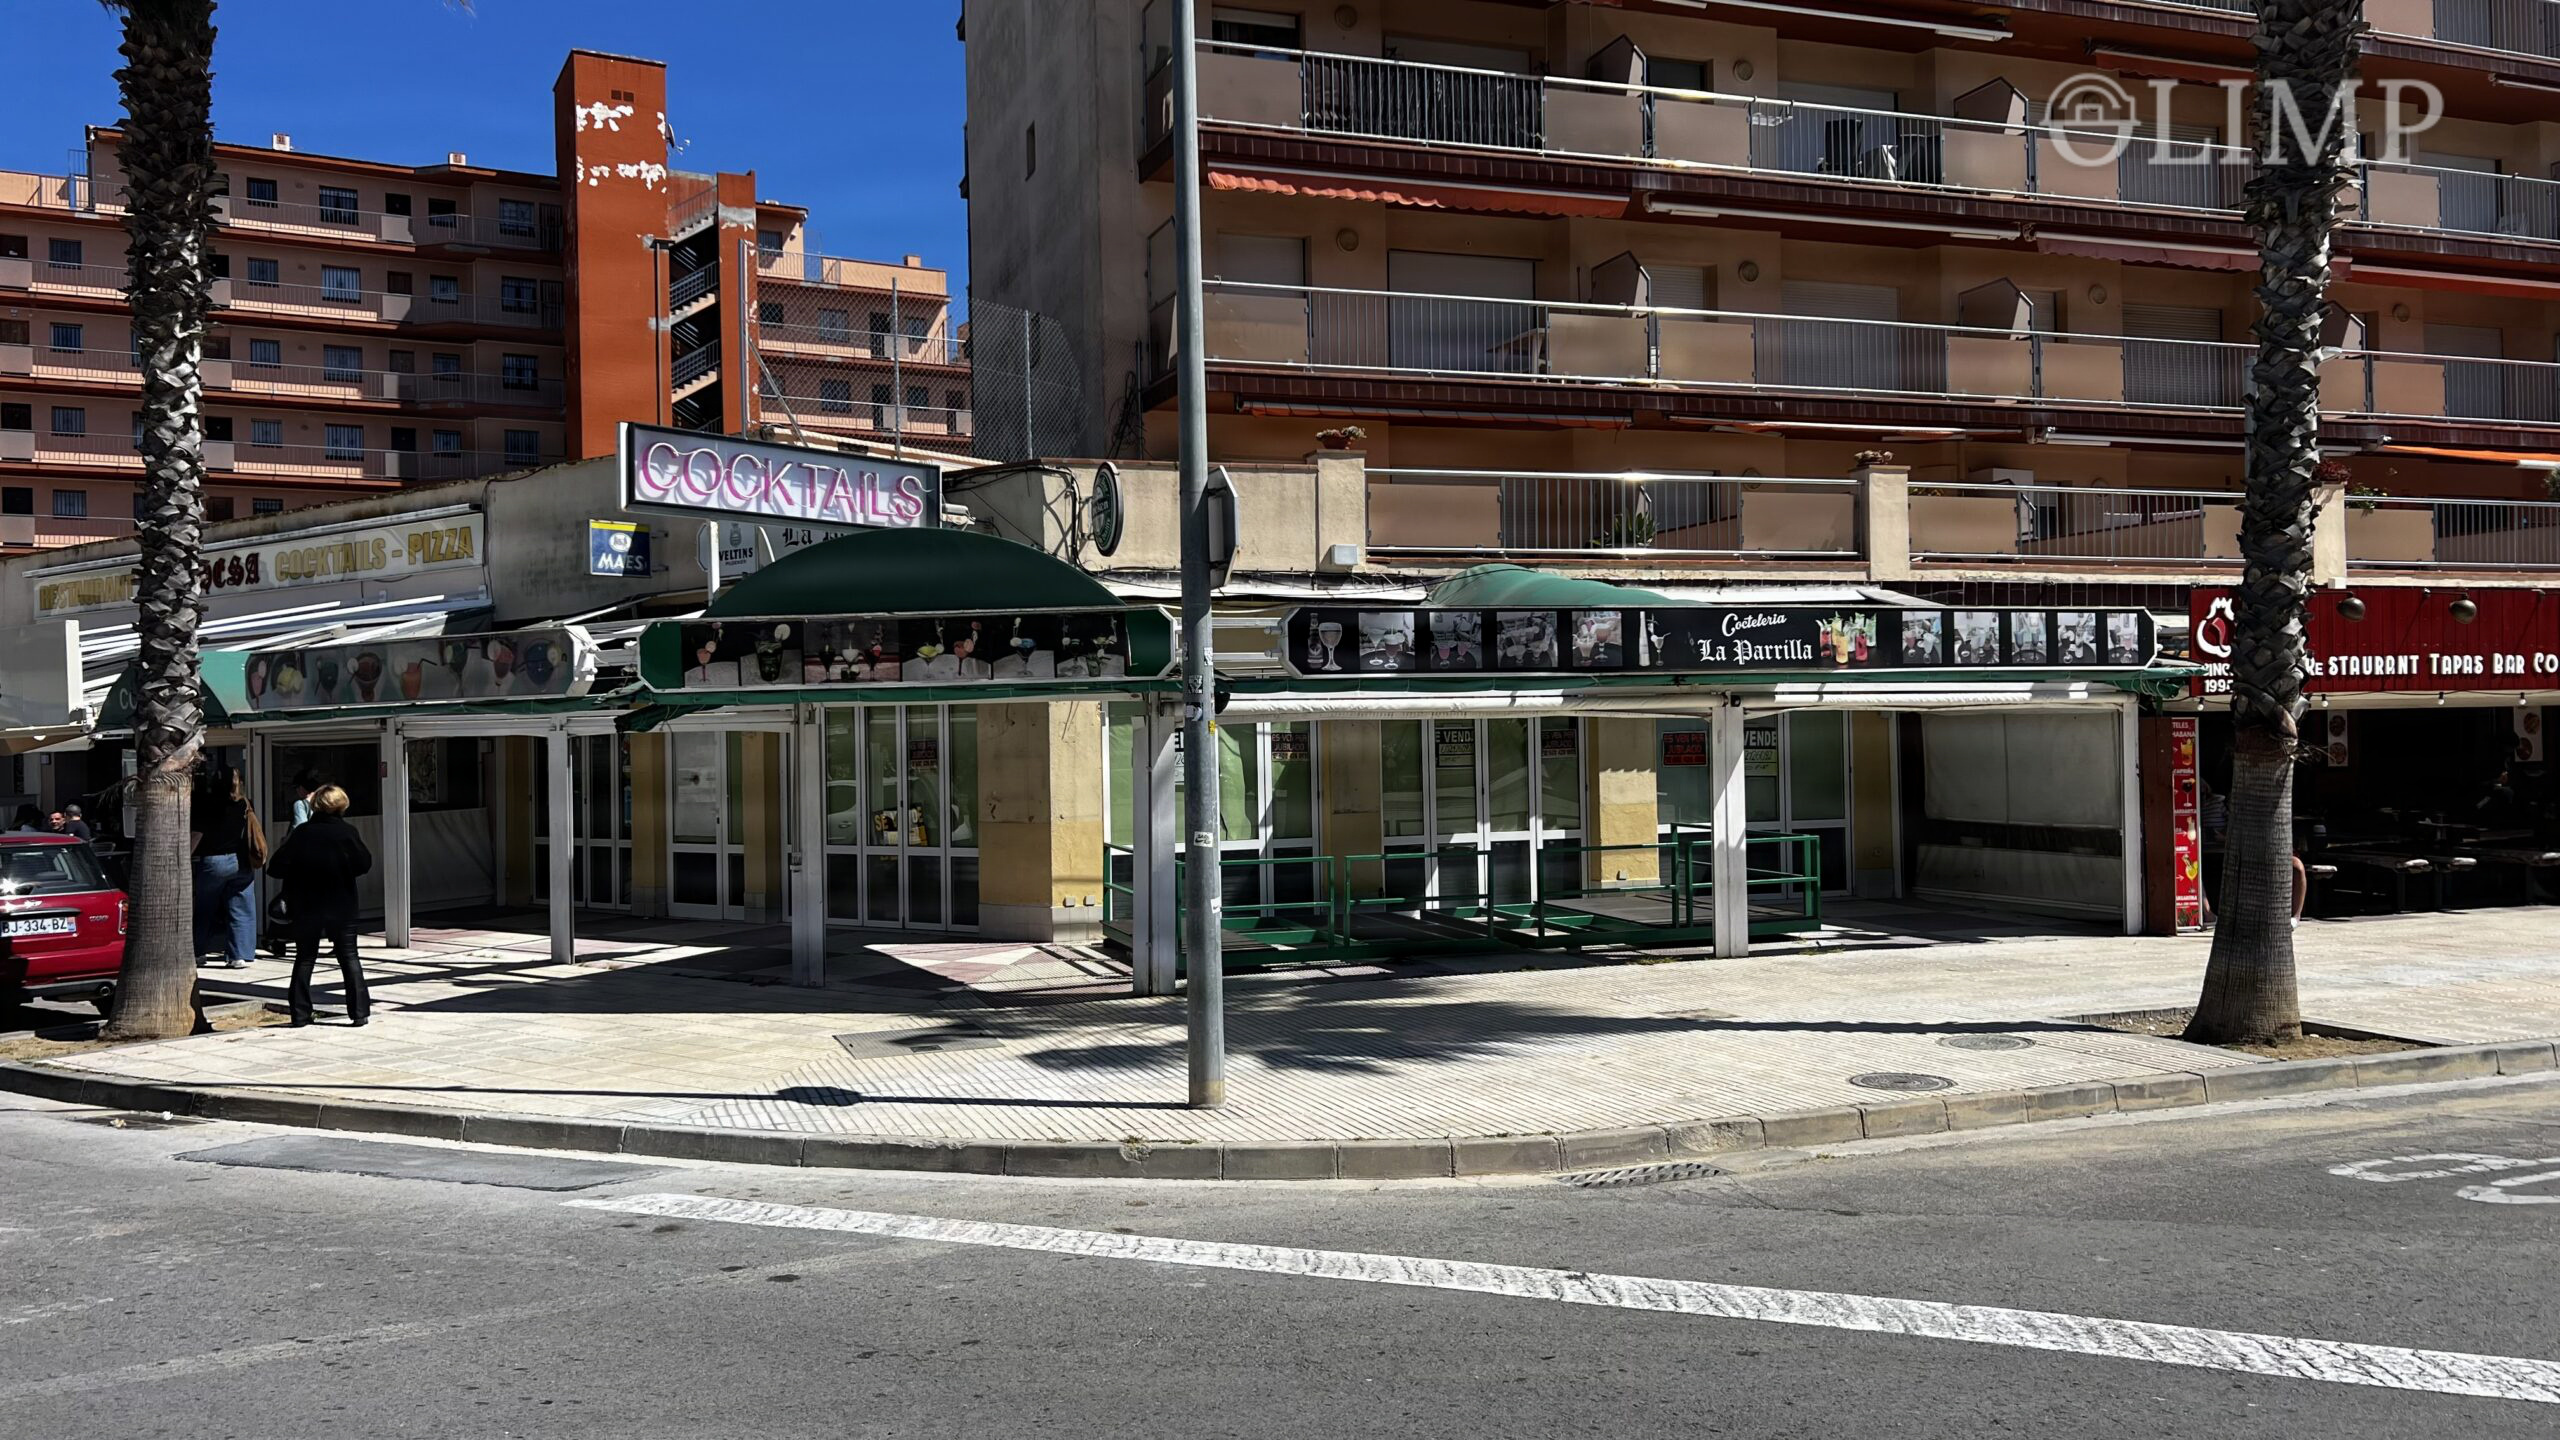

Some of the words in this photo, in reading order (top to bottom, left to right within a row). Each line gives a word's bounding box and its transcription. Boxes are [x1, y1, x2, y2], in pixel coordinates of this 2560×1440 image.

[640, 442, 933, 519] COCKTAILS
[275, 538, 386, 581] COCKTAILS
[408, 526, 473, 565] PIZZA
[597, 552, 644, 570] MAES
[719, 547, 753, 562] VELTINS
[1721, 613, 1787, 637] Cocteleria
[1697, 639, 1727, 661] La
[1732, 639, 1813, 665] Parrilla
[1443, 731, 1475, 743] VEND
[2, 917, 67, 934] BJ-334-BZ
